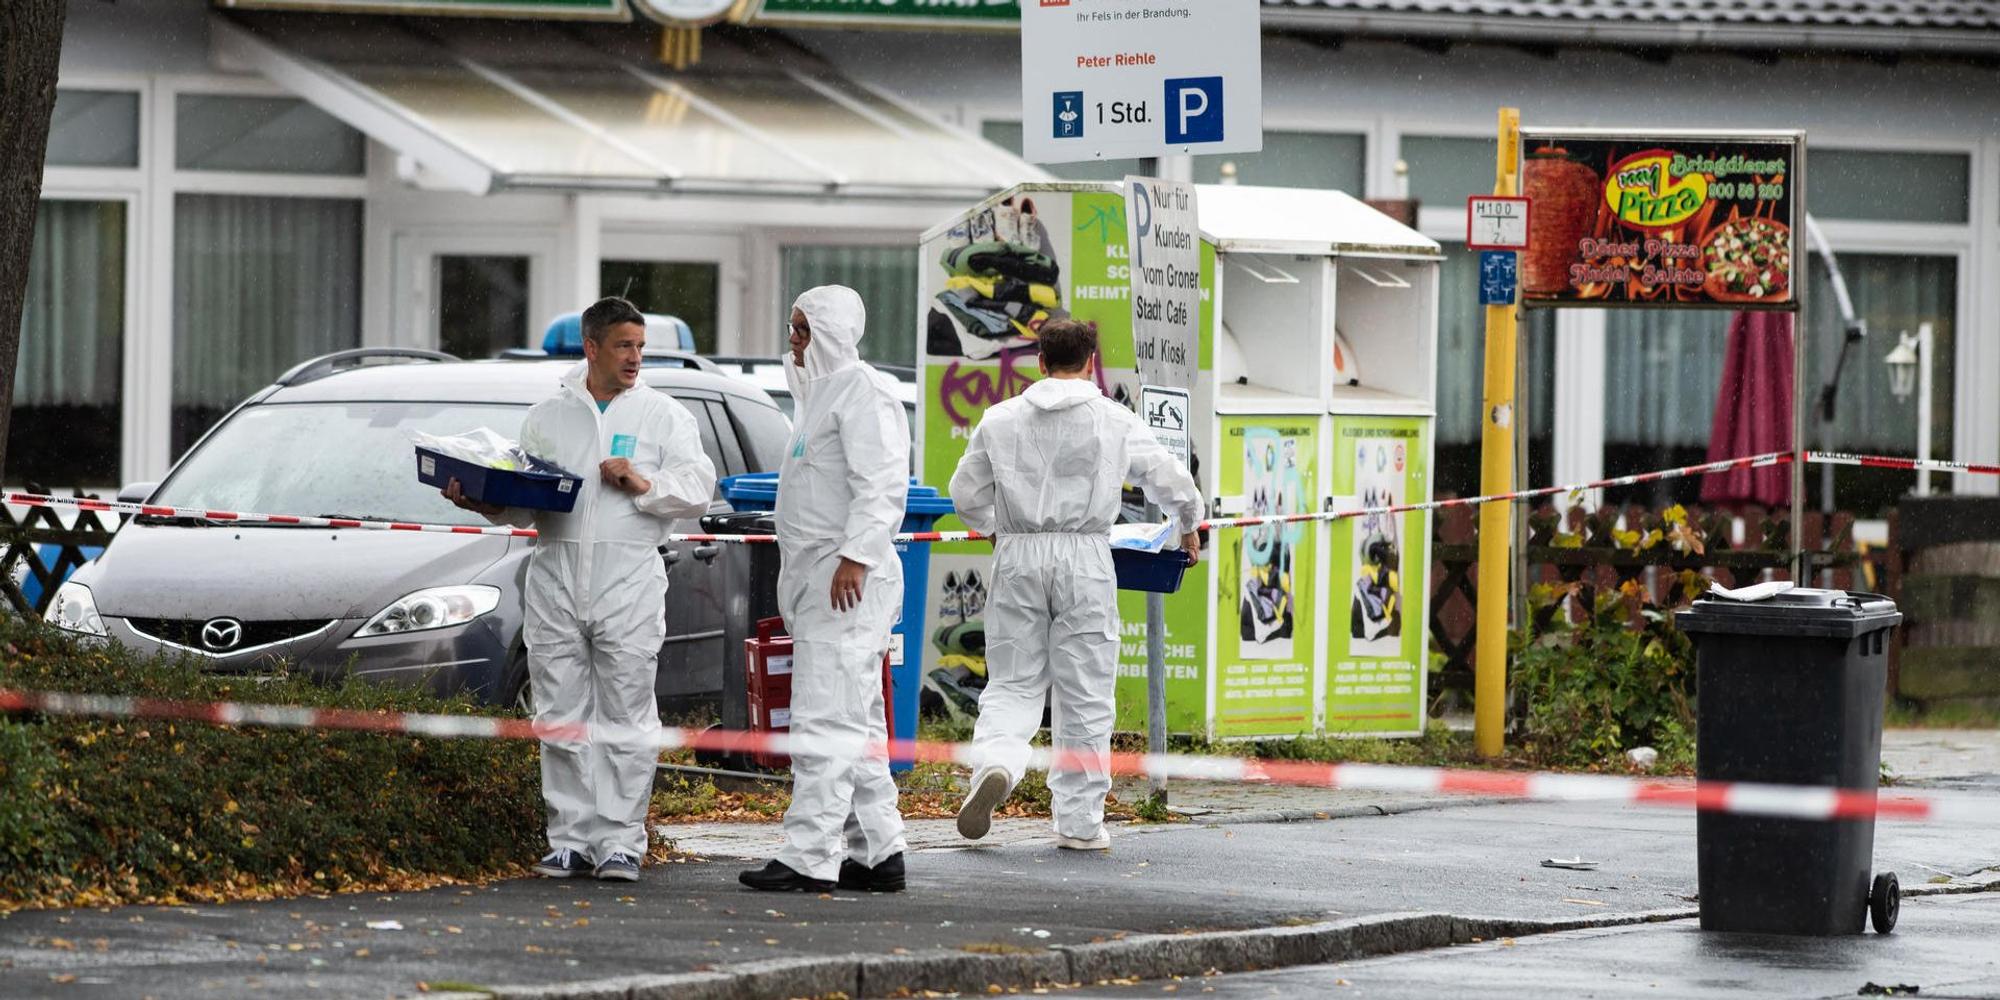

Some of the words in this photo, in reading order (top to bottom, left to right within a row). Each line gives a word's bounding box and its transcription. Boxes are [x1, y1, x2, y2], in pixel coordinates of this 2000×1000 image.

[1077, 12, 1089, 22] Ihr
[1092, 11, 1111, 21] Fels
[1113, 10, 1122, 20] in
[1125, 10, 1140, 20] der
[1142, 8, 1191, 19] Brandung.
[1077, 56, 1111, 68] Peter
[1115, 52, 1156, 66] Riehle
[1096, 102, 1103, 124] 1
[1110, 101, 1151, 124] Std.
[1179, 88, 1208, 135] P
[1670, 154, 1785, 176] Bringdienst
[1153, 186, 1171, 210] Nur
[1175, 186, 1189, 212] für
[1618, 187, 1698, 223] Pizza
[1133, 181, 1151, 268] P
[1154, 224, 1191, 250] Kunden
[1644, 239, 1698, 259] Pizza
[1142, 266, 1164, 287] vom
[1166, 264, 1199, 290] Groner
[1570, 264, 1630, 285] Nudel
[1642, 264, 1704, 286] Salate
[1136, 295, 1162, 322] Stadt
[1166, 300, 1187, 327] Café
[1136, 337, 1155, 360] und
[1161, 340, 1186, 366] Kiosk
